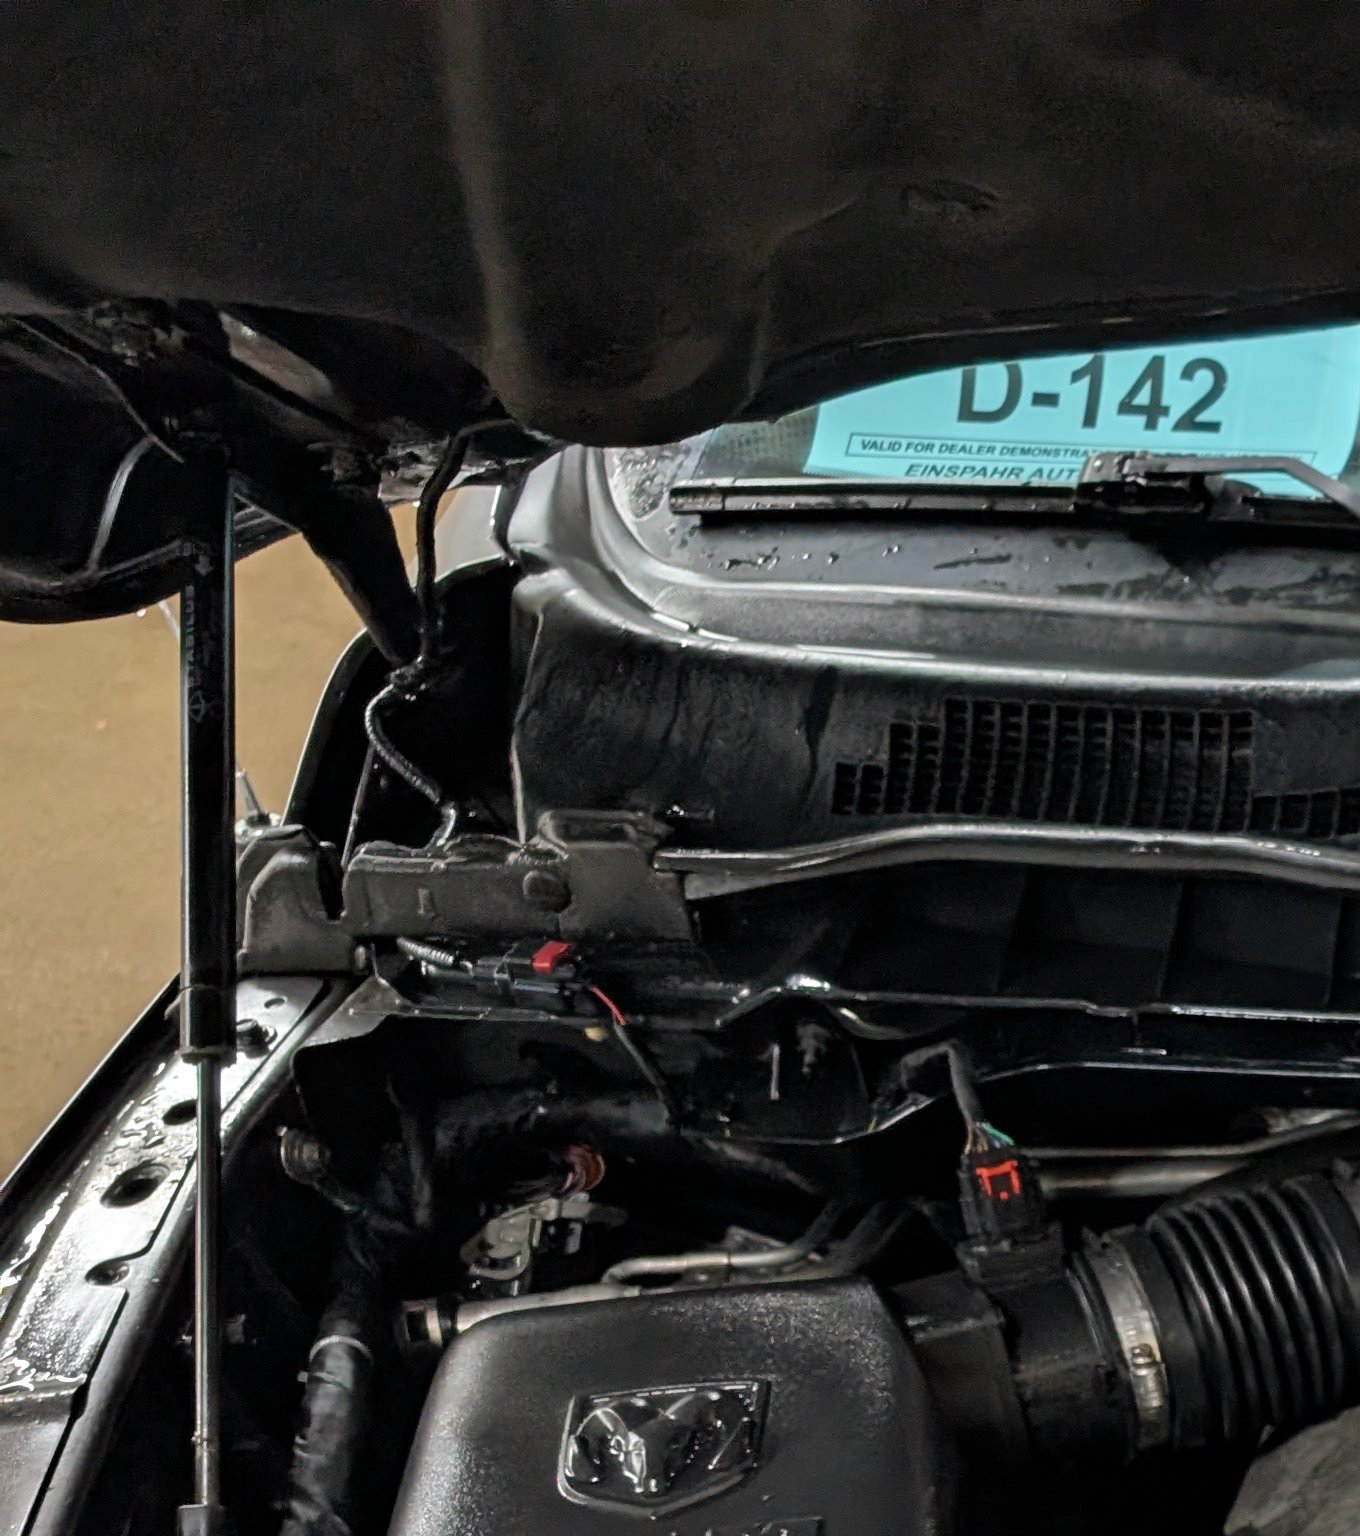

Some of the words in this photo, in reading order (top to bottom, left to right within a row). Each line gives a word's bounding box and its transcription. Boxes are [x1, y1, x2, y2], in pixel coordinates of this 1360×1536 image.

[956, 354, 1228, 432] D-142
[861, 439, 901, 452] VALID
[905, 442, 934, 454] FOR
[938, 443, 996, 456] DEALER
[999, 446, 1090, 459] DEMONSTRA
[904, 463, 1025, 480] EINSPAHR
[1027, 467, 1078, 481] AUT
